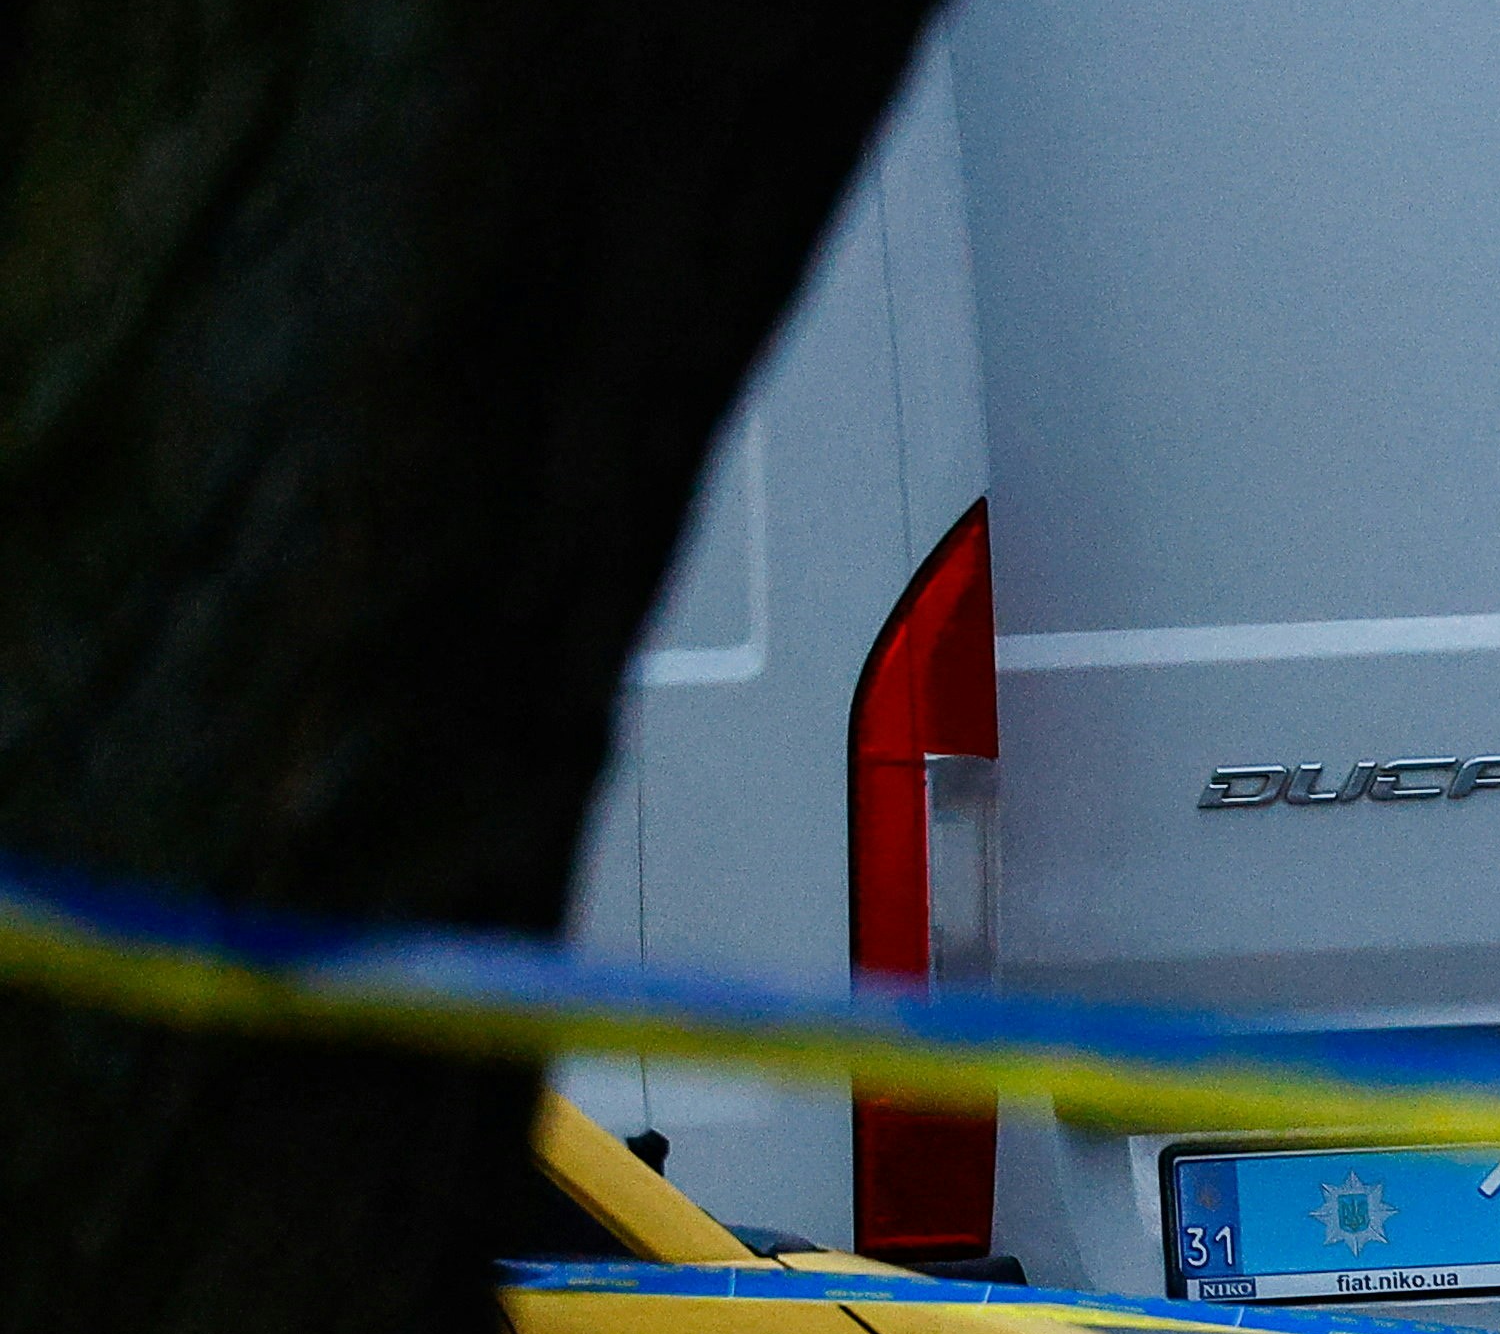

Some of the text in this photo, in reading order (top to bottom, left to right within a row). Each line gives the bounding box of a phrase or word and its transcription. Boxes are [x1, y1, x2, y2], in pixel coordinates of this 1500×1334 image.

[1186, 1225, 1233, 1267] 31
[1203, 1282, 1252, 1297] NIKO
[1336, 1271, 1458, 1293] fiat.niko.ua
